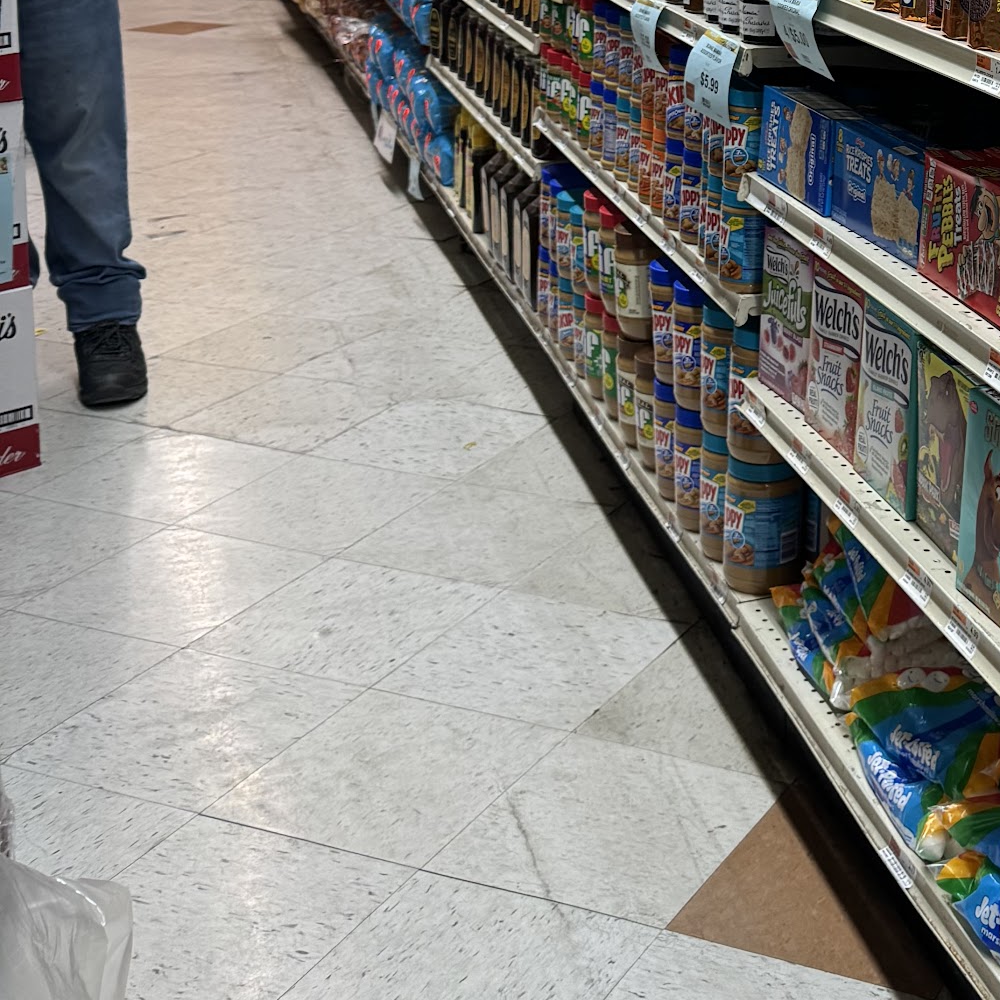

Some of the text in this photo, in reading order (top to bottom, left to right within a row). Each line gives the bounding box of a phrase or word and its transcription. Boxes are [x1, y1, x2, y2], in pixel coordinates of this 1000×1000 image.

[700, 72, 719, 94] $5.99
[846, 154, 872, 183] TREATS
[937, 174, 954, 272] PEBBLES
[767, 254, 789, 277] Welch's
[763, 281, 807, 330] Juicefuls
[814, 290, 860, 341] Welch's
[822, 354, 842, 377] Fruit
[864, 329, 909, 385] Welch's
[817, 366, 844, 396] Snacks
[872, 399, 891, 419] Fruit
